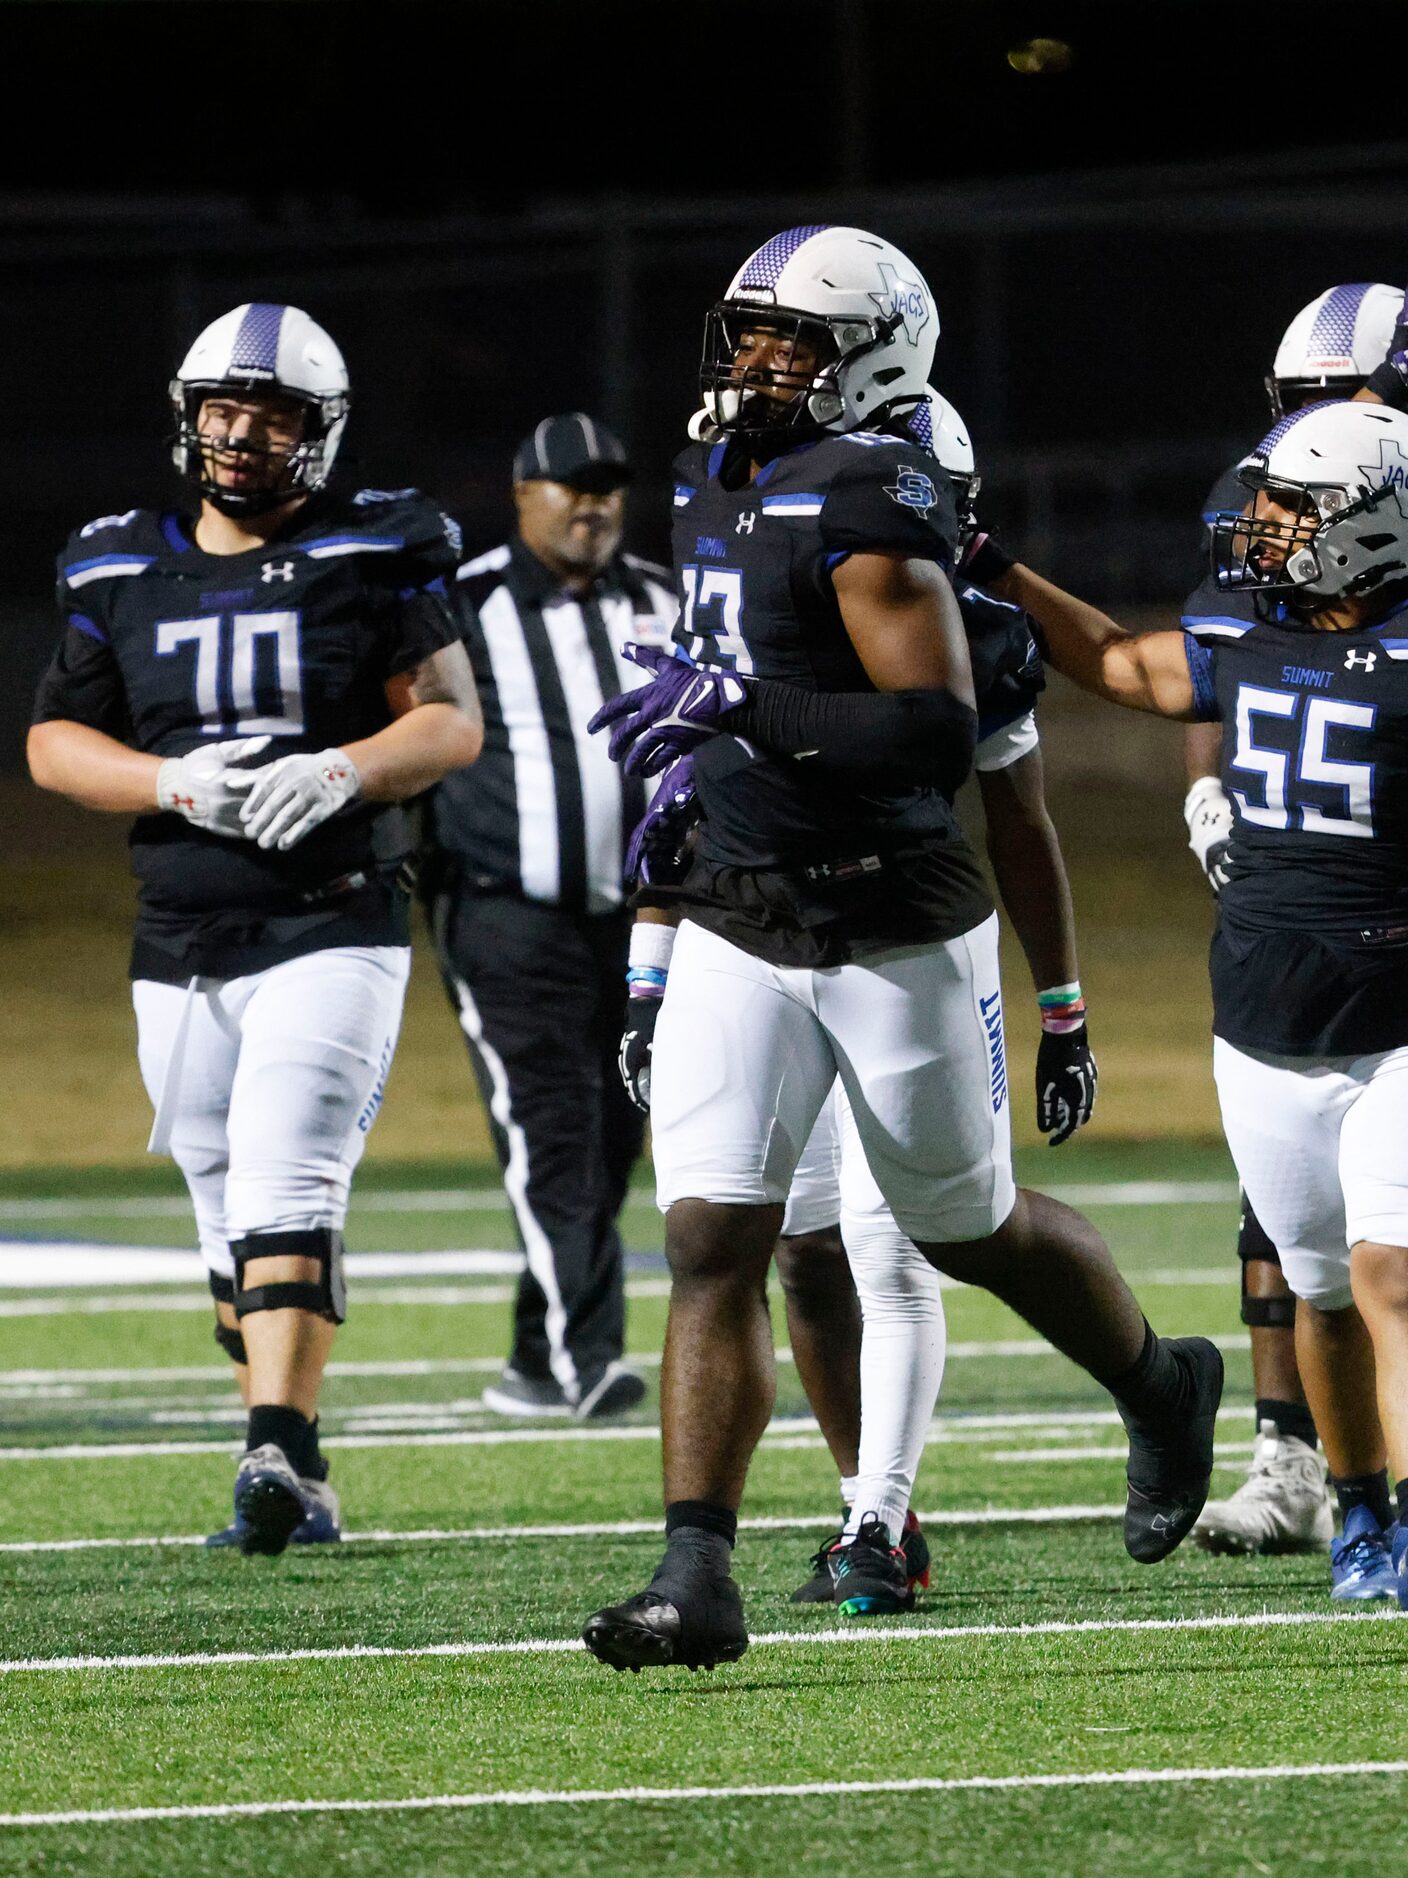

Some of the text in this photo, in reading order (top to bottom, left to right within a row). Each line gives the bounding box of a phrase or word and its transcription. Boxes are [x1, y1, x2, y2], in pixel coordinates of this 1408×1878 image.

[890, 289, 924, 318] JAGS
[154, 609, 306, 734] 70
[681, 564, 755, 676] 13
[1281, 665, 1335, 688] SUMMIT
[1228, 682, 1378, 838] 55
[979, 990, 1007, 1115] SUMMIT
